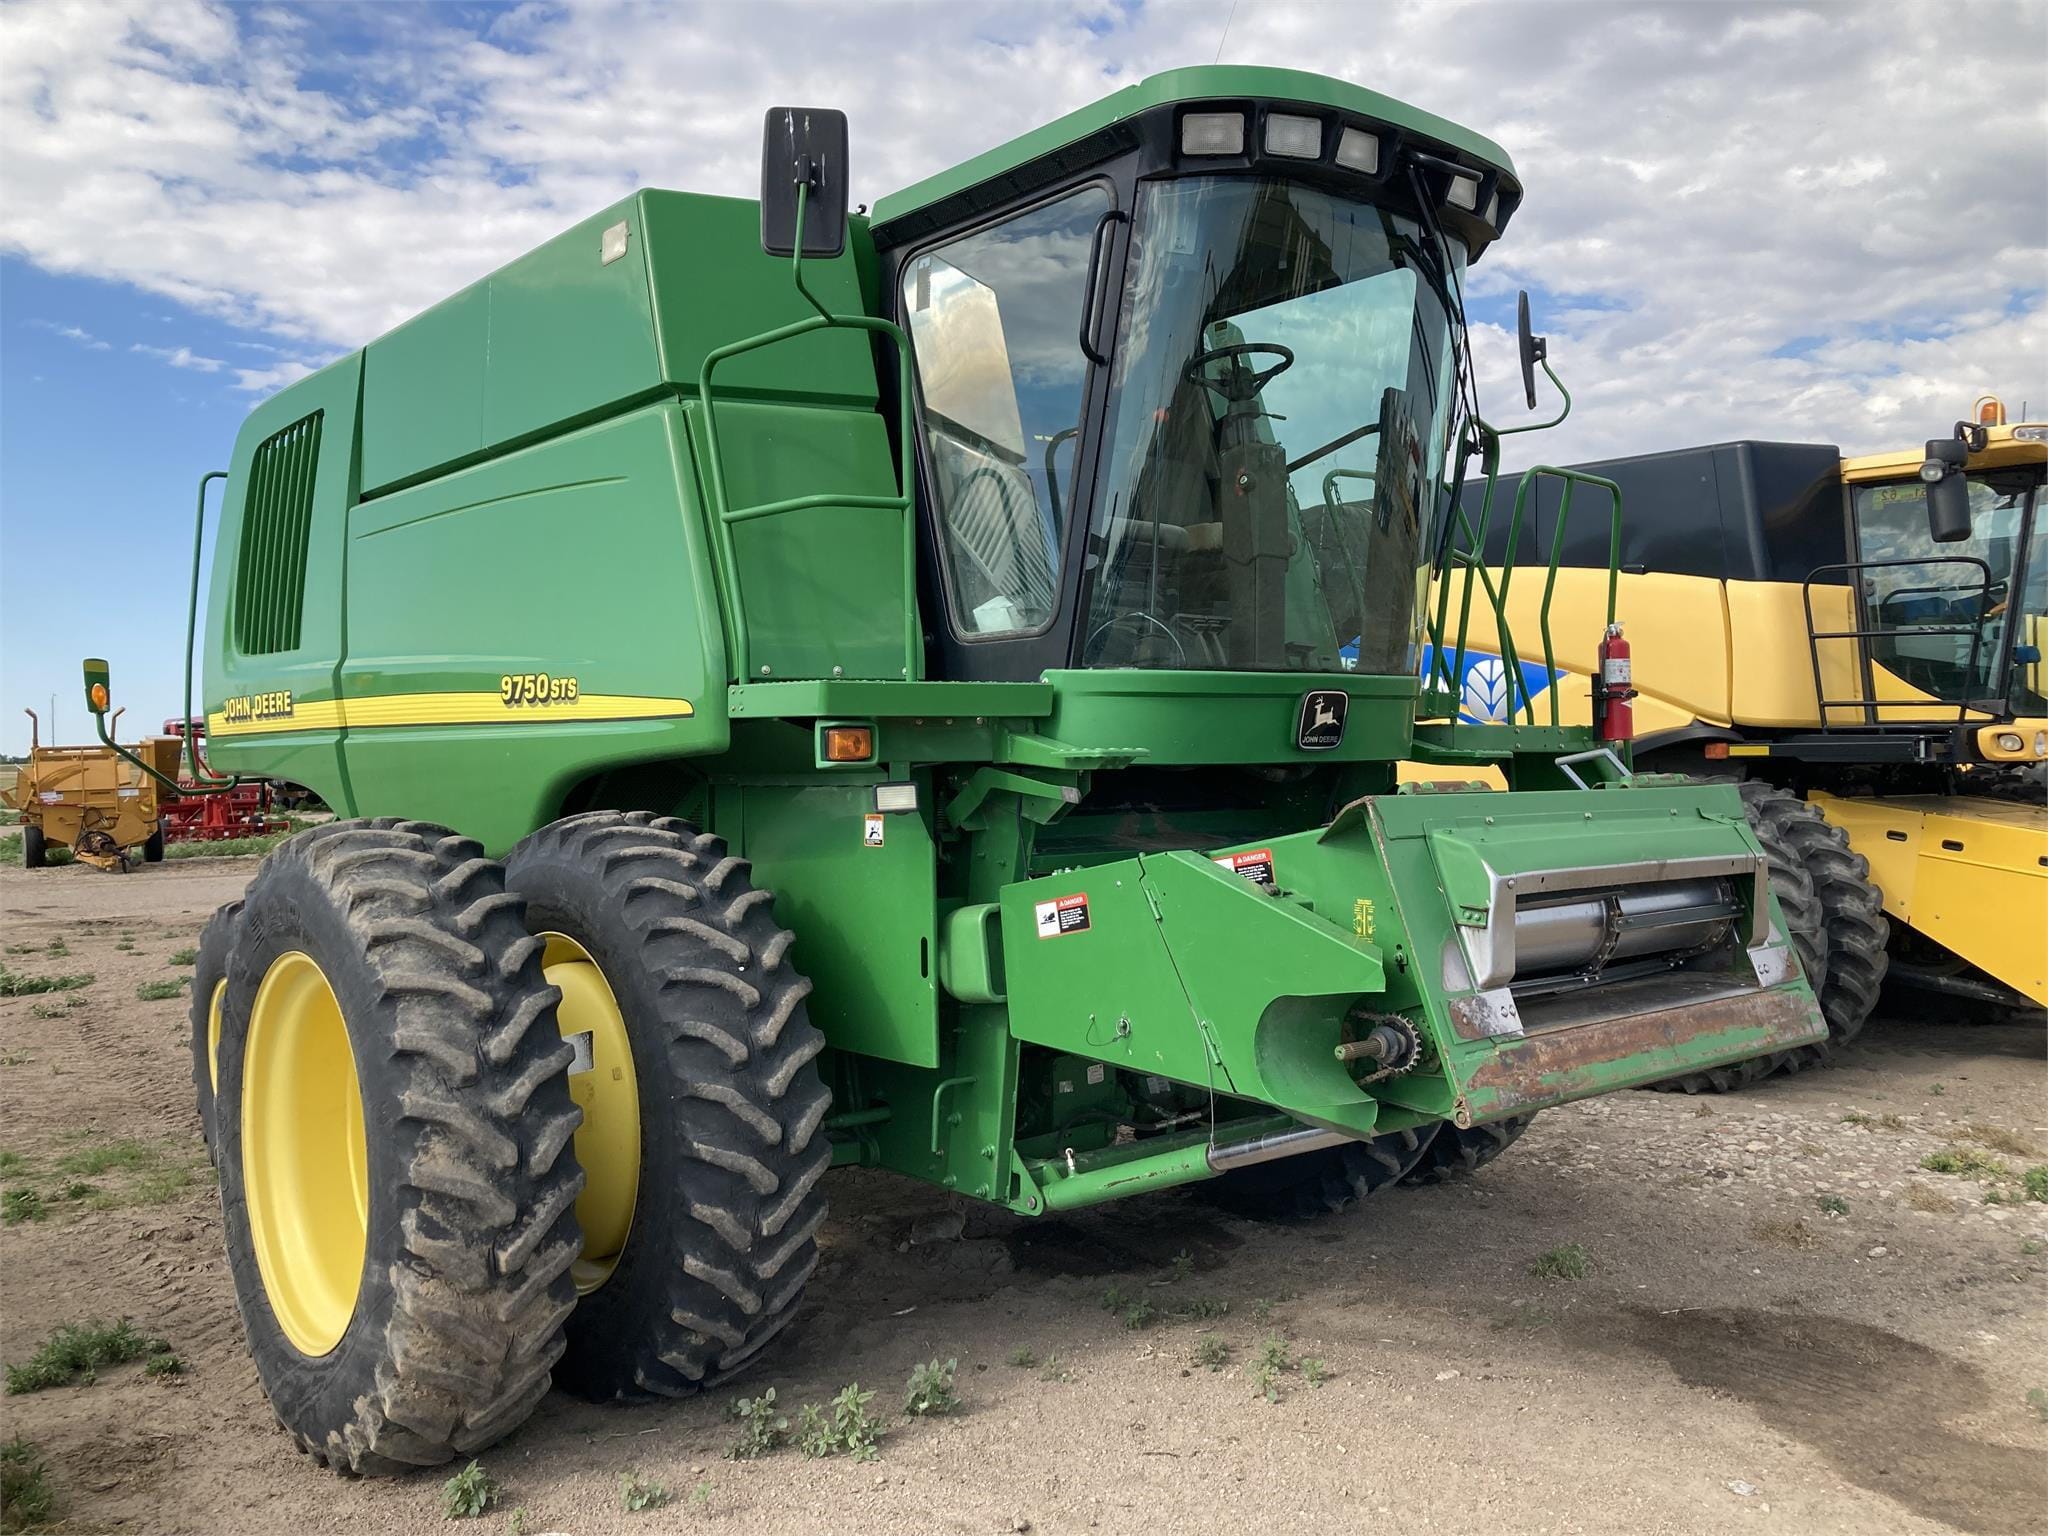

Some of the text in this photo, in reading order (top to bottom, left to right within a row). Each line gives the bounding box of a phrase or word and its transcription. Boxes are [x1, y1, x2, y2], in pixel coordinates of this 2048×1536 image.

[223, 690, 293, 720] JOHN DEERE
[1302, 735, 1339, 744] JOHN DEERE
[1242, 852, 1267, 862] DANGER
[1063, 896, 1084, 906] DANGER
